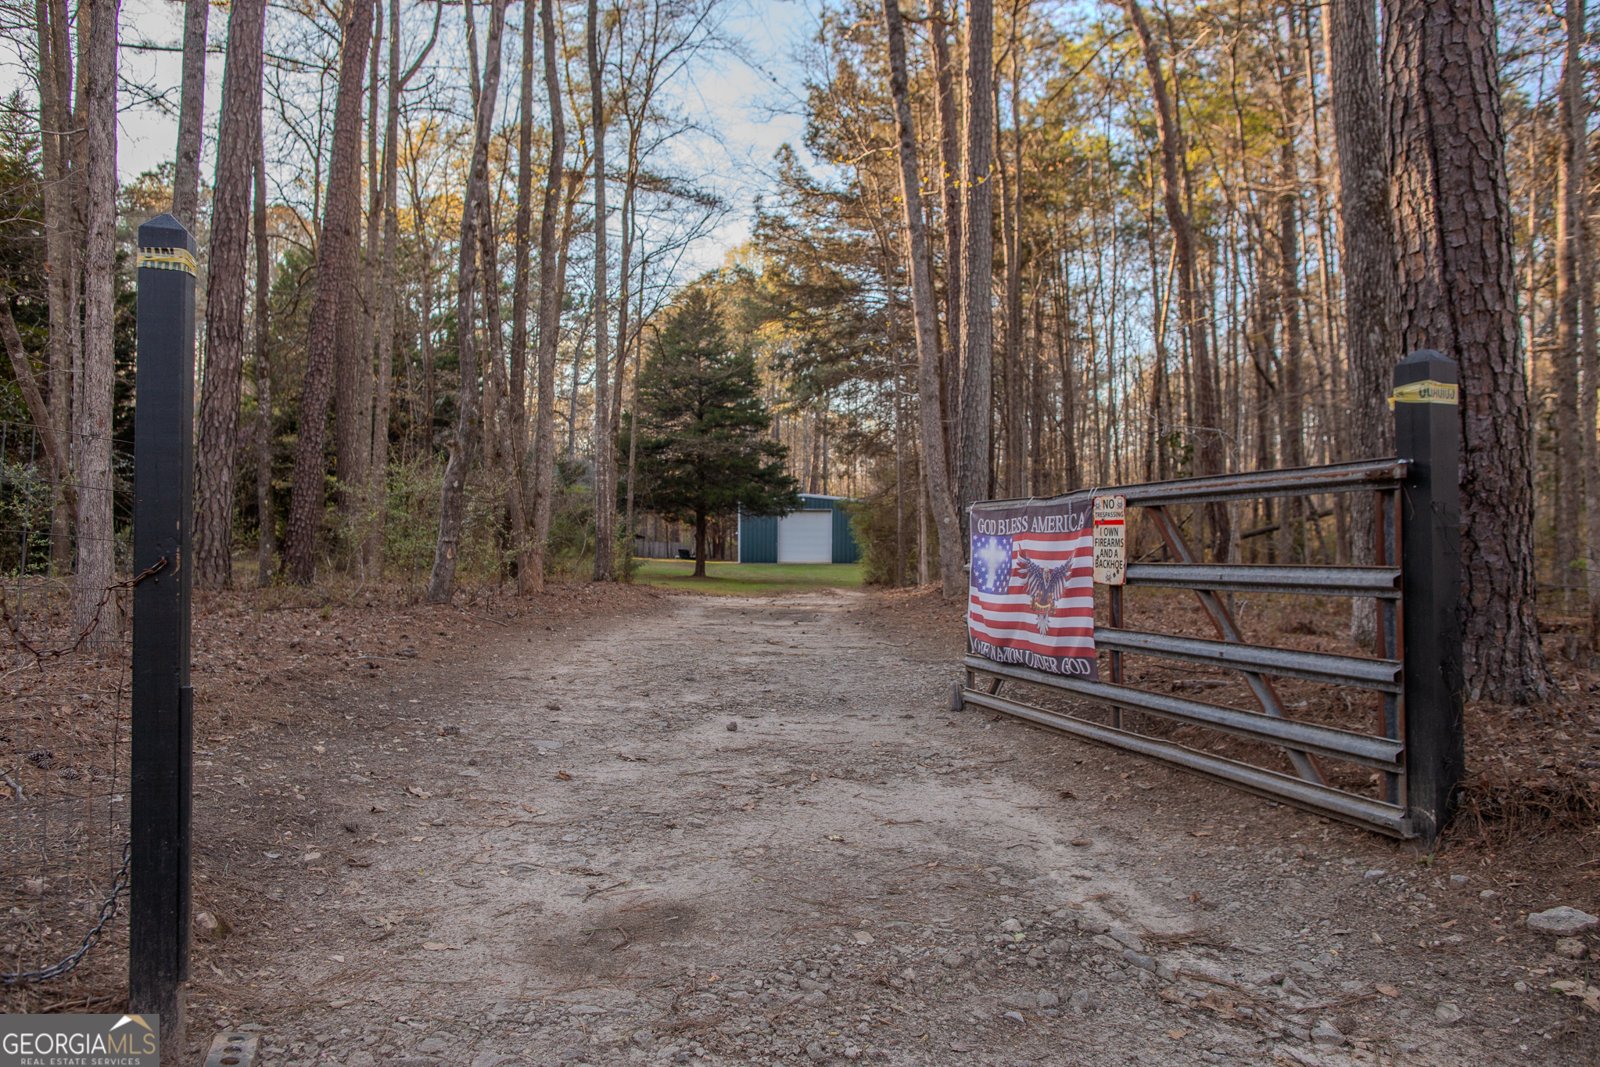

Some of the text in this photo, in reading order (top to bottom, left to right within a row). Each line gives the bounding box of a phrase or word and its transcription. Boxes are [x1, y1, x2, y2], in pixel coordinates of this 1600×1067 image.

[1103, 499, 1114, 509] NO
[977, 512, 1085, 535] GOD BLESS AMERICA
[1103, 527, 1119, 536] OWN
[1095, 538, 1124, 548] FIREARMS
[1100, 548, 1119, 559] AND A
[1095, 559, 1123, 570] BACKHOE
[1061, 657, 1091, 675] GOD
